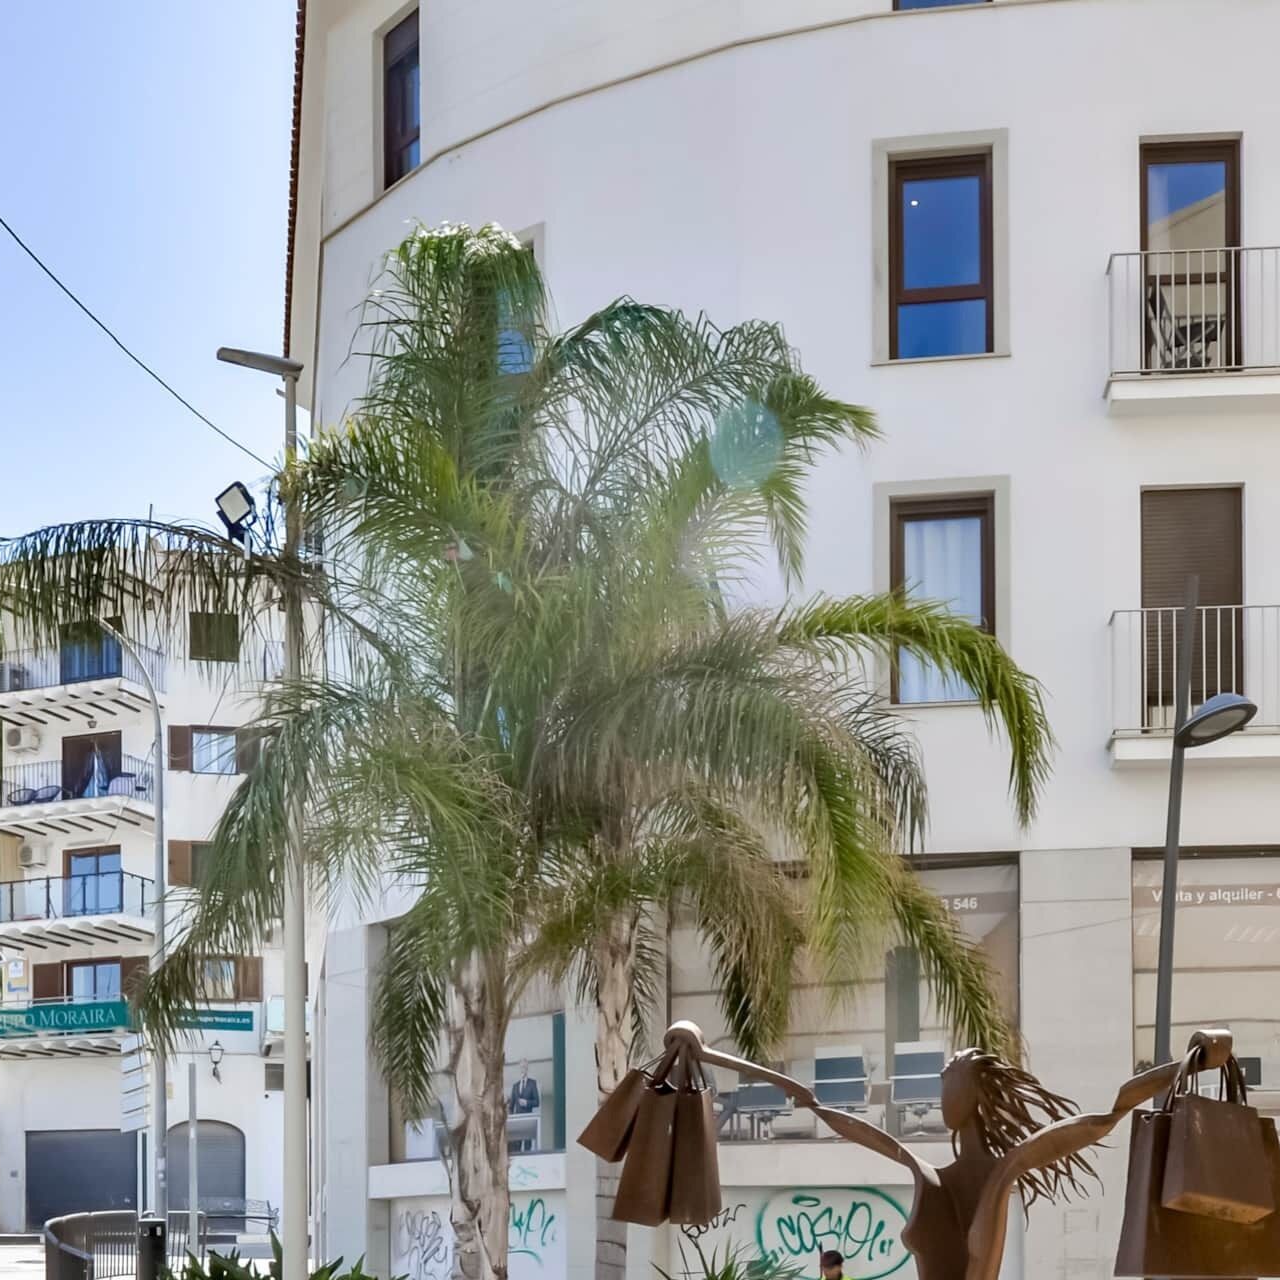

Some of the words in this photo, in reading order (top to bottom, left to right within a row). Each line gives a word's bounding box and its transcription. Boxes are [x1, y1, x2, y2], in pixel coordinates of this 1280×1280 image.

[953, 897, 977, 910] 546
[1151, 889, 1192, 902] Vta
[1196, 891, 1205, 904] y
[1209, 887, 1264, 903] alquiler
[39, 1007, 116, 1026] MORAIRA
